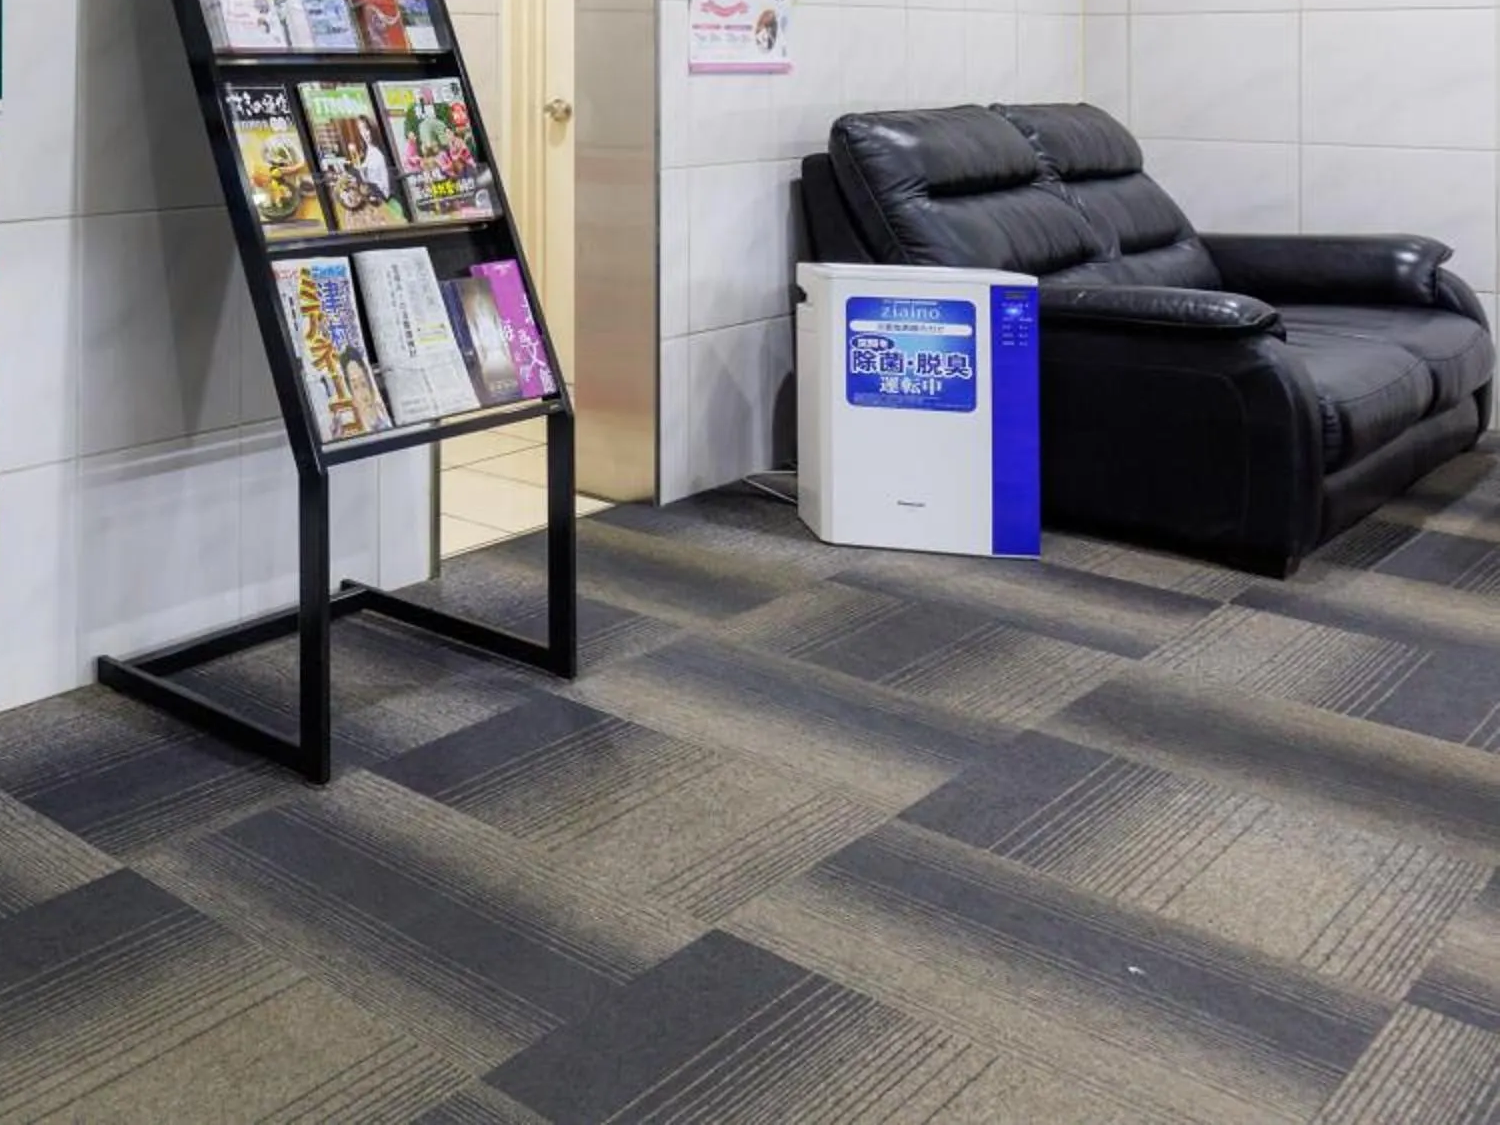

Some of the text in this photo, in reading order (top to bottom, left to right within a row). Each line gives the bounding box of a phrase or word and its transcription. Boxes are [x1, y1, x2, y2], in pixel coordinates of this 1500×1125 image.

[851, 350, 973, 379] 除菌・脱臭
[878, 376, 944, 397] 運転中
